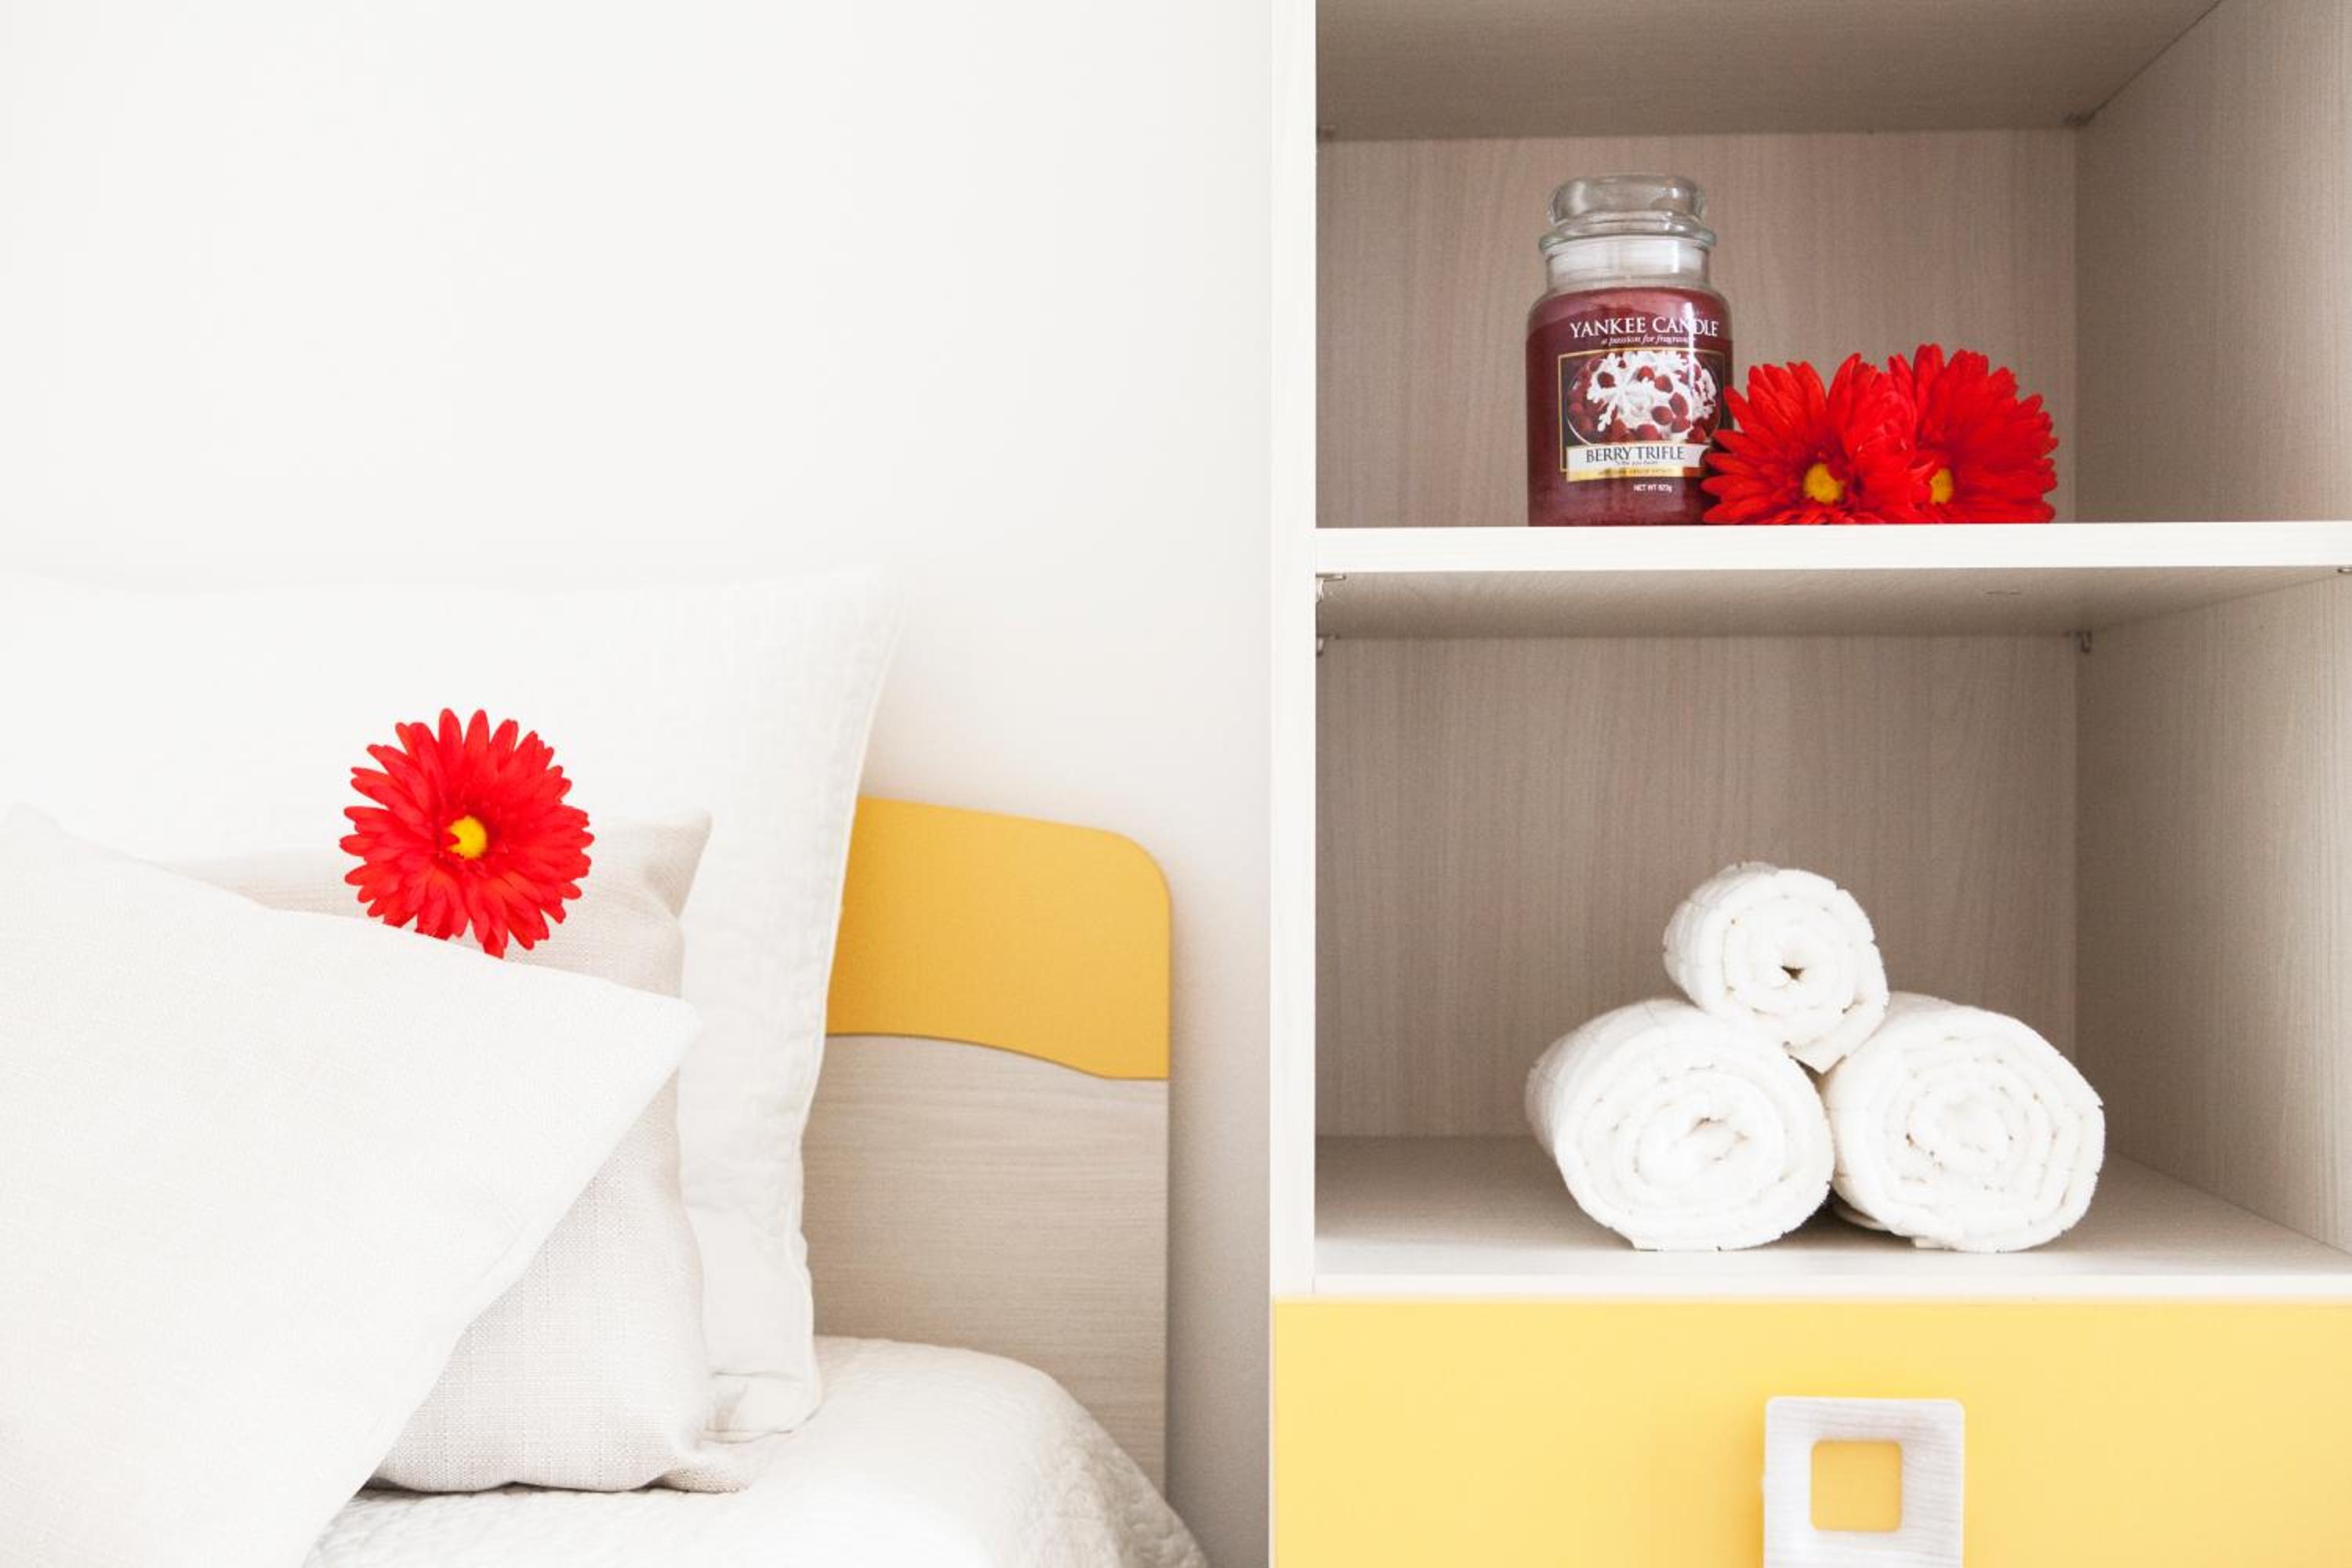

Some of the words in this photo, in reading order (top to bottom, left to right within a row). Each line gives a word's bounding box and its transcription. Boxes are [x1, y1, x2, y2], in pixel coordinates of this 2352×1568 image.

[1570, 317, 1646, 338] YANKEE
[1652, 316, 1719, 337] CANDLE
[1609, 336, 1641, 346] passion
[1642, 333, 1656, 345] for
[1586, 447, 1632, 463] BERRY
[1637, 445, 1684, 461] TRIFLE
